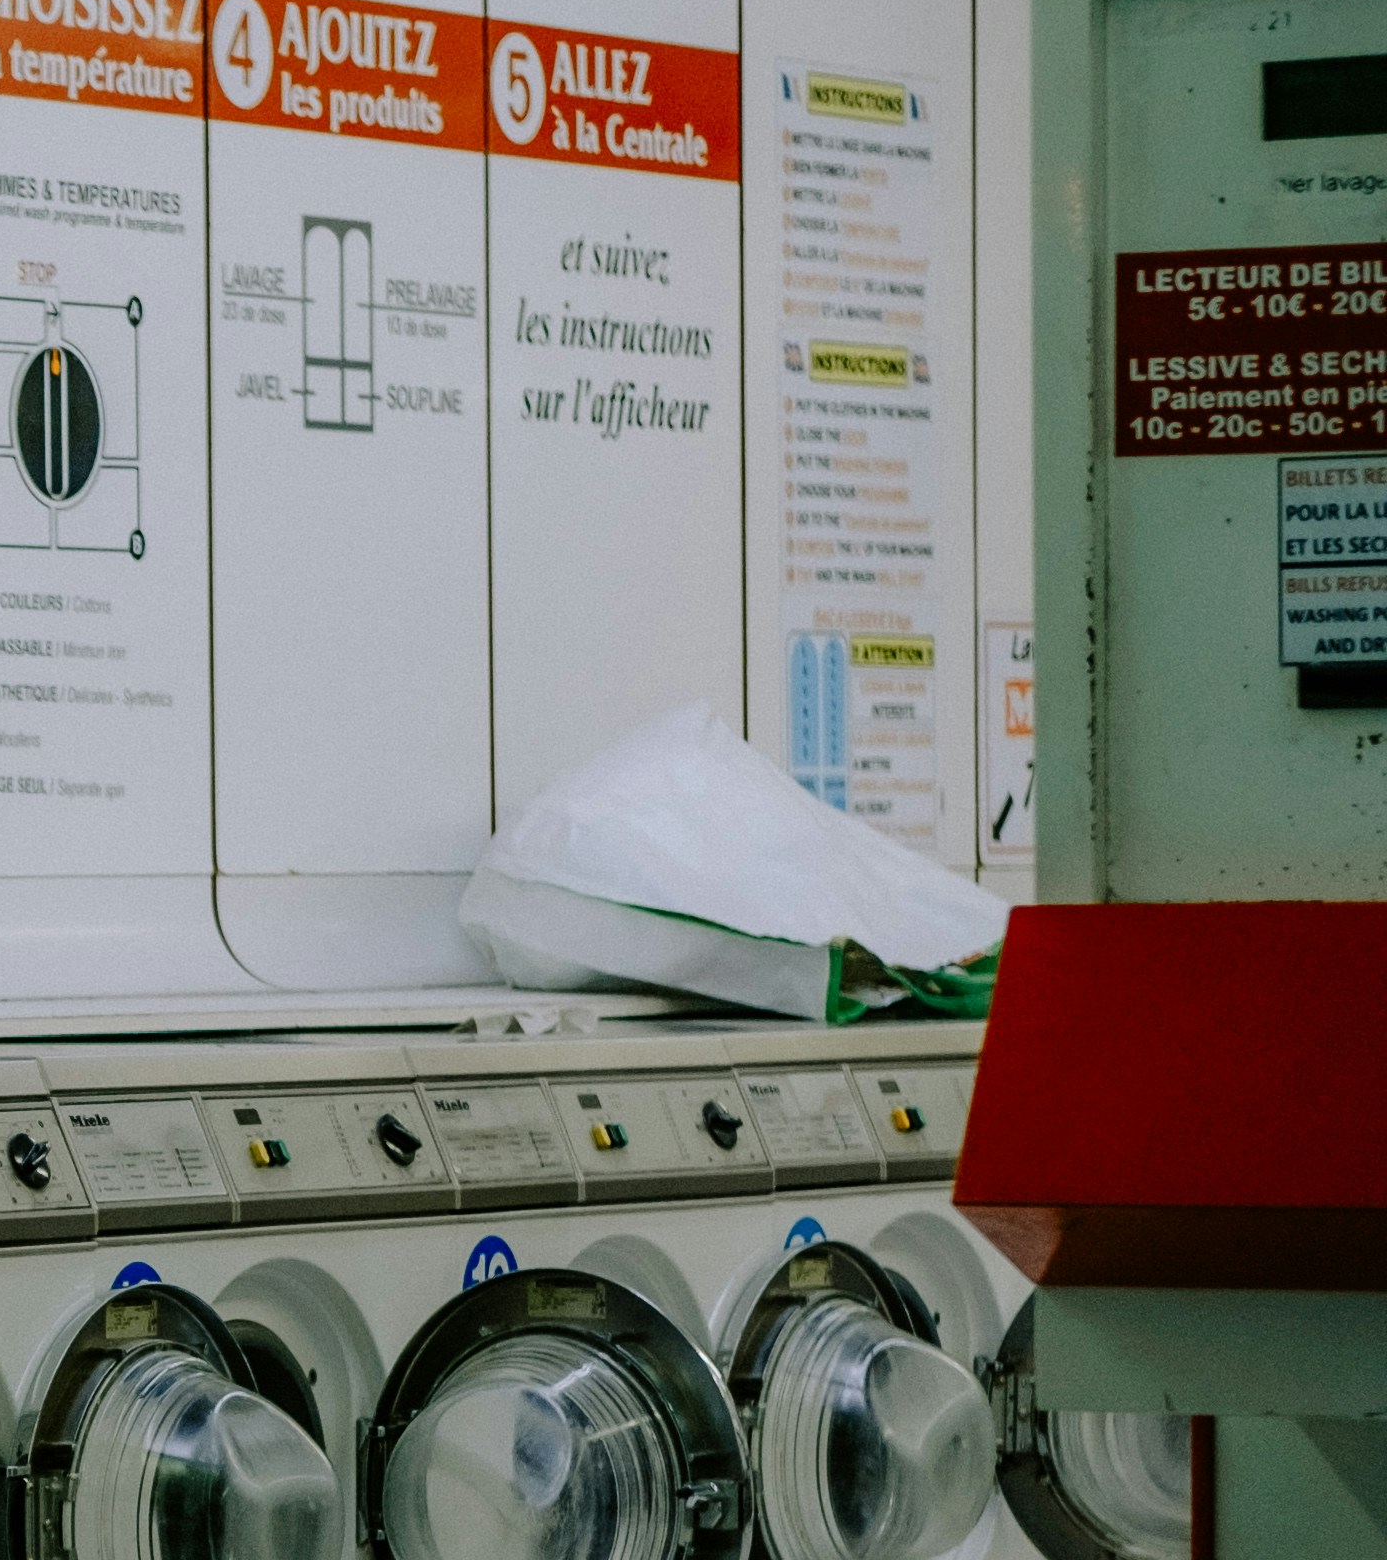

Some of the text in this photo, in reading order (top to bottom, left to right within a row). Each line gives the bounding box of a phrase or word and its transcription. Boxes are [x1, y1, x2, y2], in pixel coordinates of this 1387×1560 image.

[279, 2, 438, 77] AJOUTEZ
[9, 39, 194, 103] température
[551, 40, 653, 106] ALLEZ
[280, 71, 444, 135] les produits
[552, 106, 708, 167] à la Centrale
[58, 180, 181, 216] TEMPERATURES
[561, 234, 670, 284] et suivez
[1136, 264, 1281, 293] LECTEUR
[1290, 262, 1331, 287] DE
[1188, 296, 1225, 320] 5€
[1251, 292, 1306, 318] 10€
[517, 297, 713, 358] les instructions
[1129, 354, 1260, 381] LESSIVE
[1268, 353, 1291, 377] &
[522, 385, 565, 423] sur
[1151, 384, 1339, 410] Paiement en
[1129, 411, 1344, 440] 10c 20c 50c
[1286, 467, 1357, 486] BILLETS
[1286, 503, 1367, 521] POUR LA
[1286, 538, 1344, 556] ET LES
[1287, 607, 1367, 624] WASHING
[69, 1114, 110, 1128] Miele
